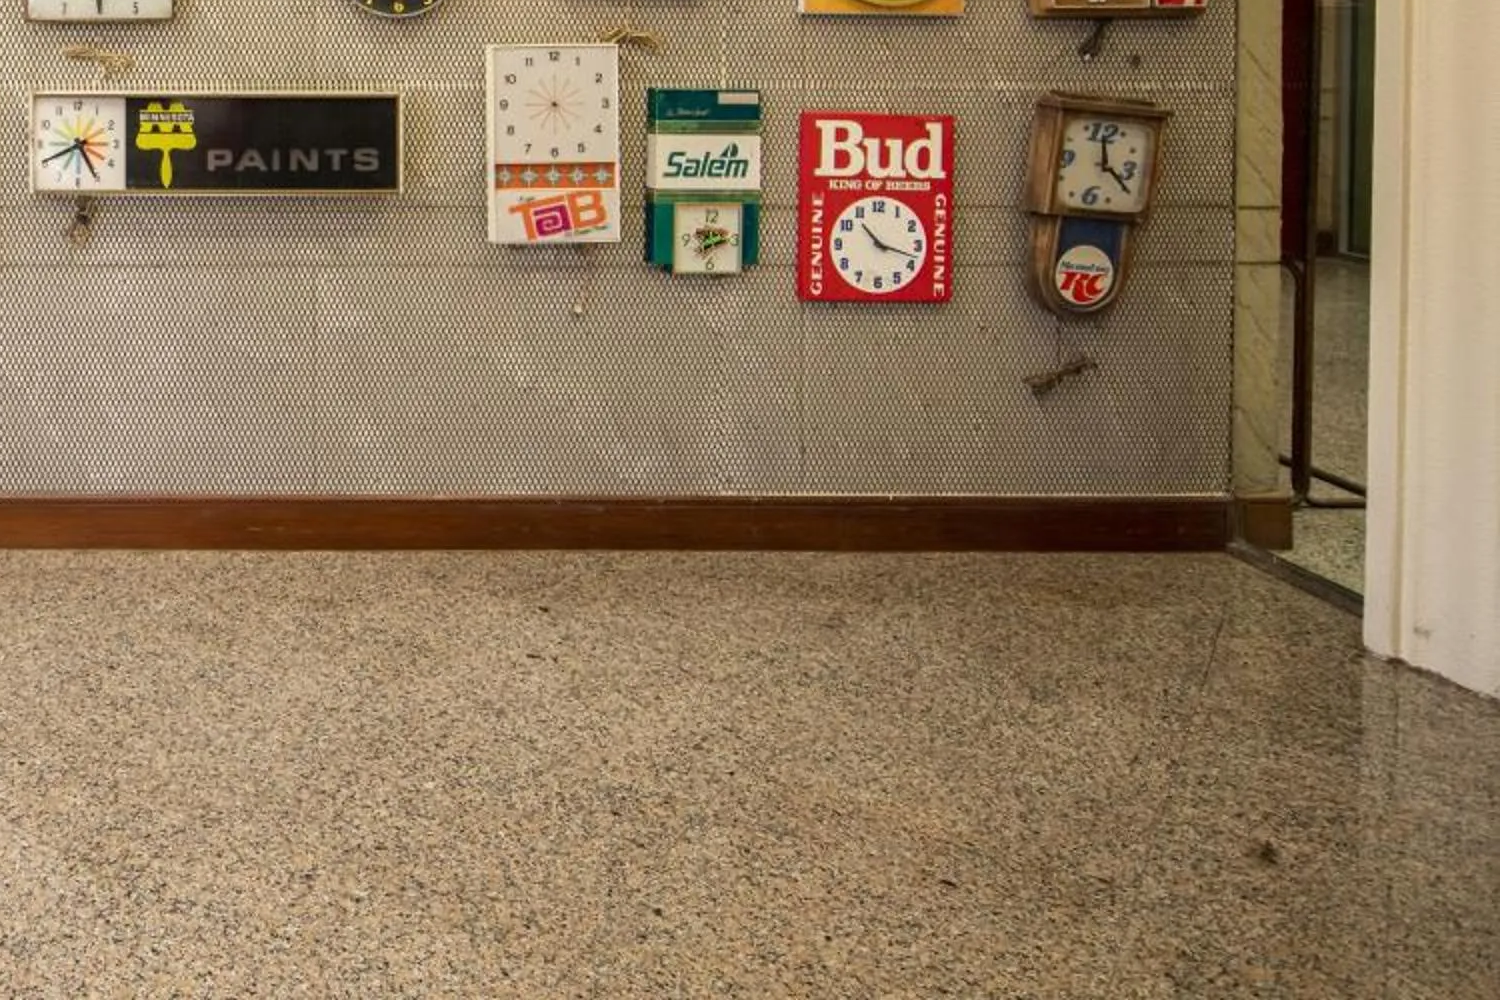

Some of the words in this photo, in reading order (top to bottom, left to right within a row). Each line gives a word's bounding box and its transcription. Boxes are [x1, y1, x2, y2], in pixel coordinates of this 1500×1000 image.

[814, 119, 946, 179] Bud
[207, 149, 380, 171] PAINTS
[663, 151, 749, 178] Salem
[855, 207, 864, 218] 11
[872, 201, 885, 212] 12
[895, 206, 899, 218] 1
[840, 220, 853, 231] 10
[908, 220, 916, 232] 2
[811, 192, 824, 295] GENUINE
[834, 238, 842, 250] 9
[914, 240, 922, 252] 3
[933, 194, 946, 297] GENUINE
[840, 258, 849, 269] 8
[906, 260, 914, 271] 4
[855, 272, 862, 282] 7
[873, 277, 882, 288] 6
[893, 272, 900, 283] 5
